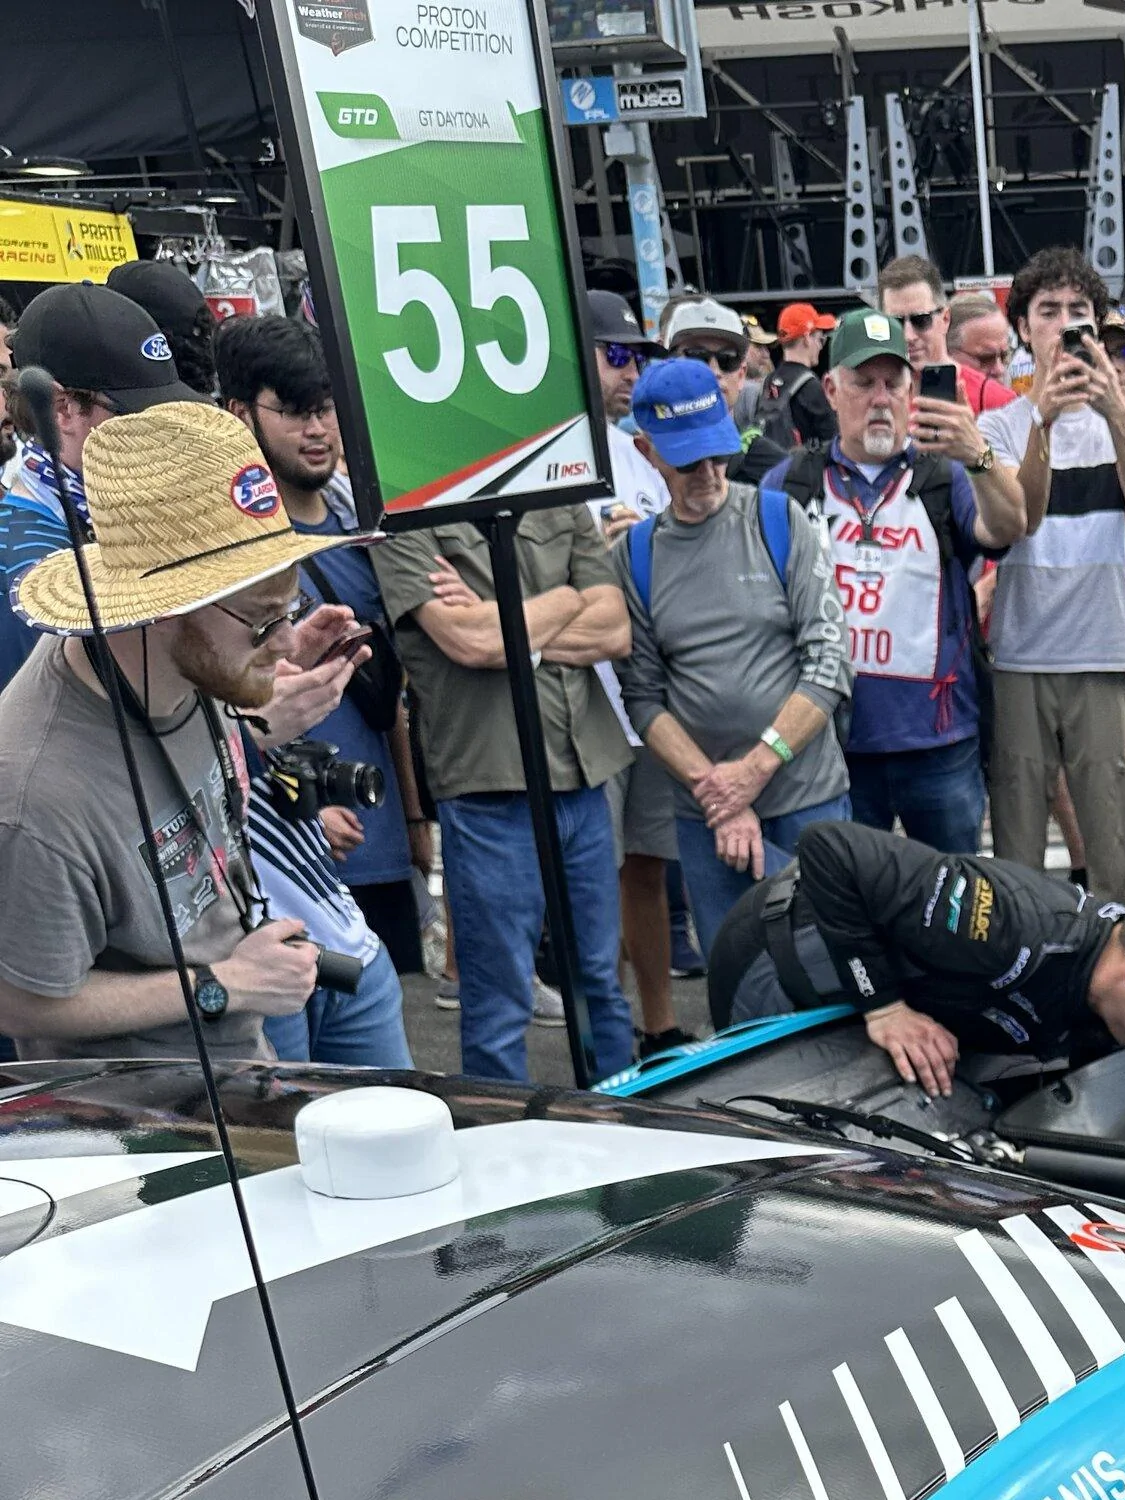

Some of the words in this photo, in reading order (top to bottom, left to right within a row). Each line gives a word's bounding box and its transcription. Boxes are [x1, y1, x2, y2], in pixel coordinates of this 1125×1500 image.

[418, 5, 487, 30] PROTON
[396, 27, 513, 55] COMPETITION
[620, 92, 682, 109] musco
[338, 108, 379, 126] GTD
[419, 110, 436, 127] GT
[437, 111, 490, 129] DAYTONA
[80, 223, 121, 242] PRATT
[85, 244, 127, 262] MILLER
[371, 205, 550, 404] 55
[241, 481, 252, 504] 5
[835, 564, 885, 615] 58
